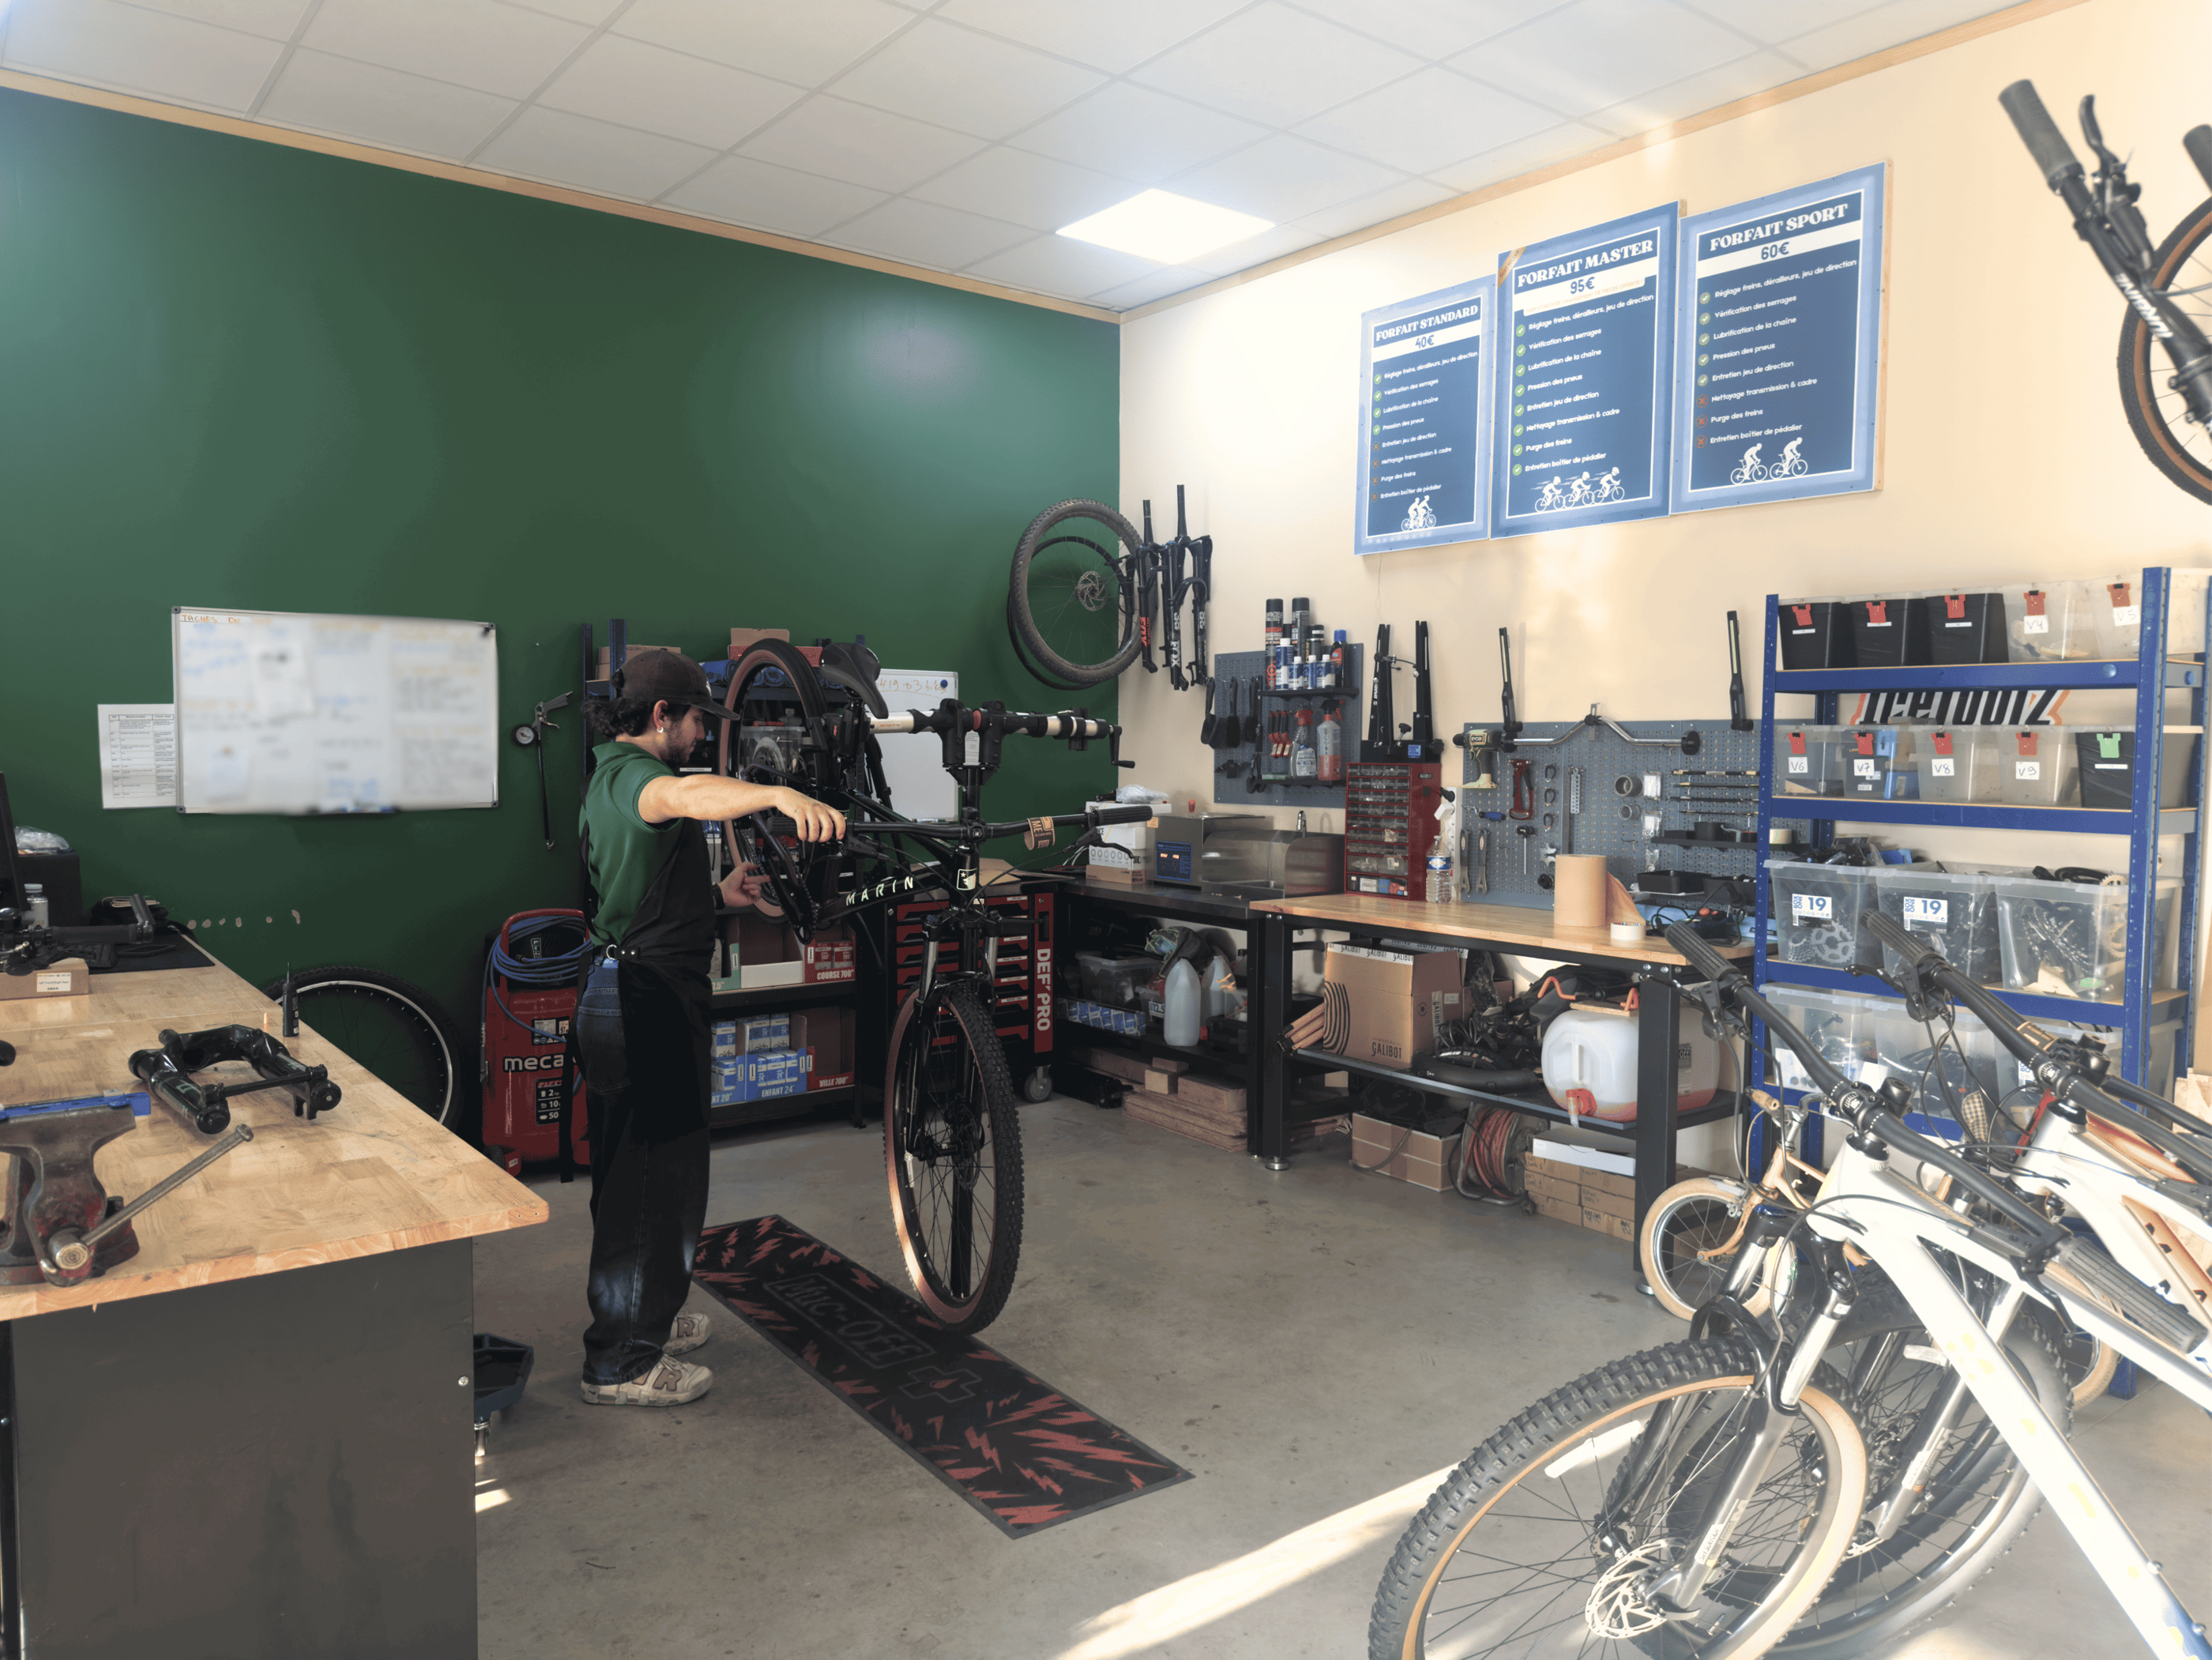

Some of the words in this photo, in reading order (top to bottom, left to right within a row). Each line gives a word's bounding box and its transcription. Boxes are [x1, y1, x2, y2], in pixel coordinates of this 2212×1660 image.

[1710, 221, 1783, 251] FORFAIT
[1785, 204, 1848, 231] SPORT
[1761, 242, 1789, 260] 60€
[1518, 259, 1582, 287] FORFAIT
[1585, 240, 1653, 269] MASTER
[1571, 277, 1595, 294] 95€
[1715, 287, 1741, 298] Réglage
[1743, 282, 1762, 291] freins,
[1764, 273, 1800, 287] dérailleurs,
[1802, 270, 1813, 279] jeu
[1825, 260, 1856, 273] direction
[1529, 320, 1552, 330] Réglage
[1553, 314, 1571, 324] freins,
[1573, 307, 1604, 319] dérailleurs,
[1626, 295, 1653, 306] direction
[1715, 305, 1752, 318] Vérification
[1766, 295, 1796, 307] serrages
[1376, 322, 1419, 341] FORFAIT
[1420, 305, 1478, 329] STANDARD
[1714, 326, 1754, 340] Lubrification
[1774, 318, 1796, 327] chaîne
[1416, 335, 1435, 348] 40€
[1529, 338, 1562, 349] Vérification
[1575, 329, 1601, 339] serrages
[1528, 357, 1563, 371] Lubrification
[1581, 349, 1601, 358] chaîne
[1713, 350, 1740, 360] Pression
[1755, 343, 1775, 353] pneus
[1384, 371, 1401, 379] Réglage
[1416, 361, 1441, 371] dérailleurs,
[1458, 352, 1477, 360] direction
[1712, 371, 1741, 381] Entretien
[1765, 361, 1793, 371] direction
[1384, 386, 1409, 395] Vérification
[1528, 381, 1551, 391] Pression
[1564, 375, 1582, 384] pneus
[1712, 390, 1745, 402] Nettoyage
[1746, 383, 1789, 396] transmission
[1797, 378, 1817, 387] cadre
[1383, 403, 1410, 413] Lubrification
[1527, 401, 1552, 411] Entretien
[1573, 392, 1599, 401] direction
[1526, 420, 1556, 431] Nettoyage
[1557, 413, 1594, 425] transmission
[1710, 434, 1740, 443] Entretien
[1740, 431, 1762, 439] boîtier
[1774, 424, 1802, 435] pédalier
[1405, 450, 1433, 460] transmission
[1525, 461, 1551, 472] Entretien
[1552, 458, 1571, 467] boîtier
[1582, 452, 1606, 463] pédalier
[2116, 609, 2136, 621] V5
[2026, 619, 2043, 630] V4
[1170, 640, 1181, 668] FOX
[913, 680, 923, 691] 3
[1791, 761, 1804, 772] V6
[1857, 762, 1871, 773] V7
[1935, 763, 1951, 774] V8
[2018, 766, 2037, 778] V9
[846, 876, 914, 906] MARIN
[1808, 897, 1826, 911] 19
[1921, 899, 1942, 915] 19
[1367, 949, 1387, 958] GALIBOT
[817, 971, 841, 980] COURSE
[1037, 993, 1051, 1031] PRO
[1371, 1042, 1401, 1060] GALIBOT
[762, 1088, 783, 1097] ENFANT
